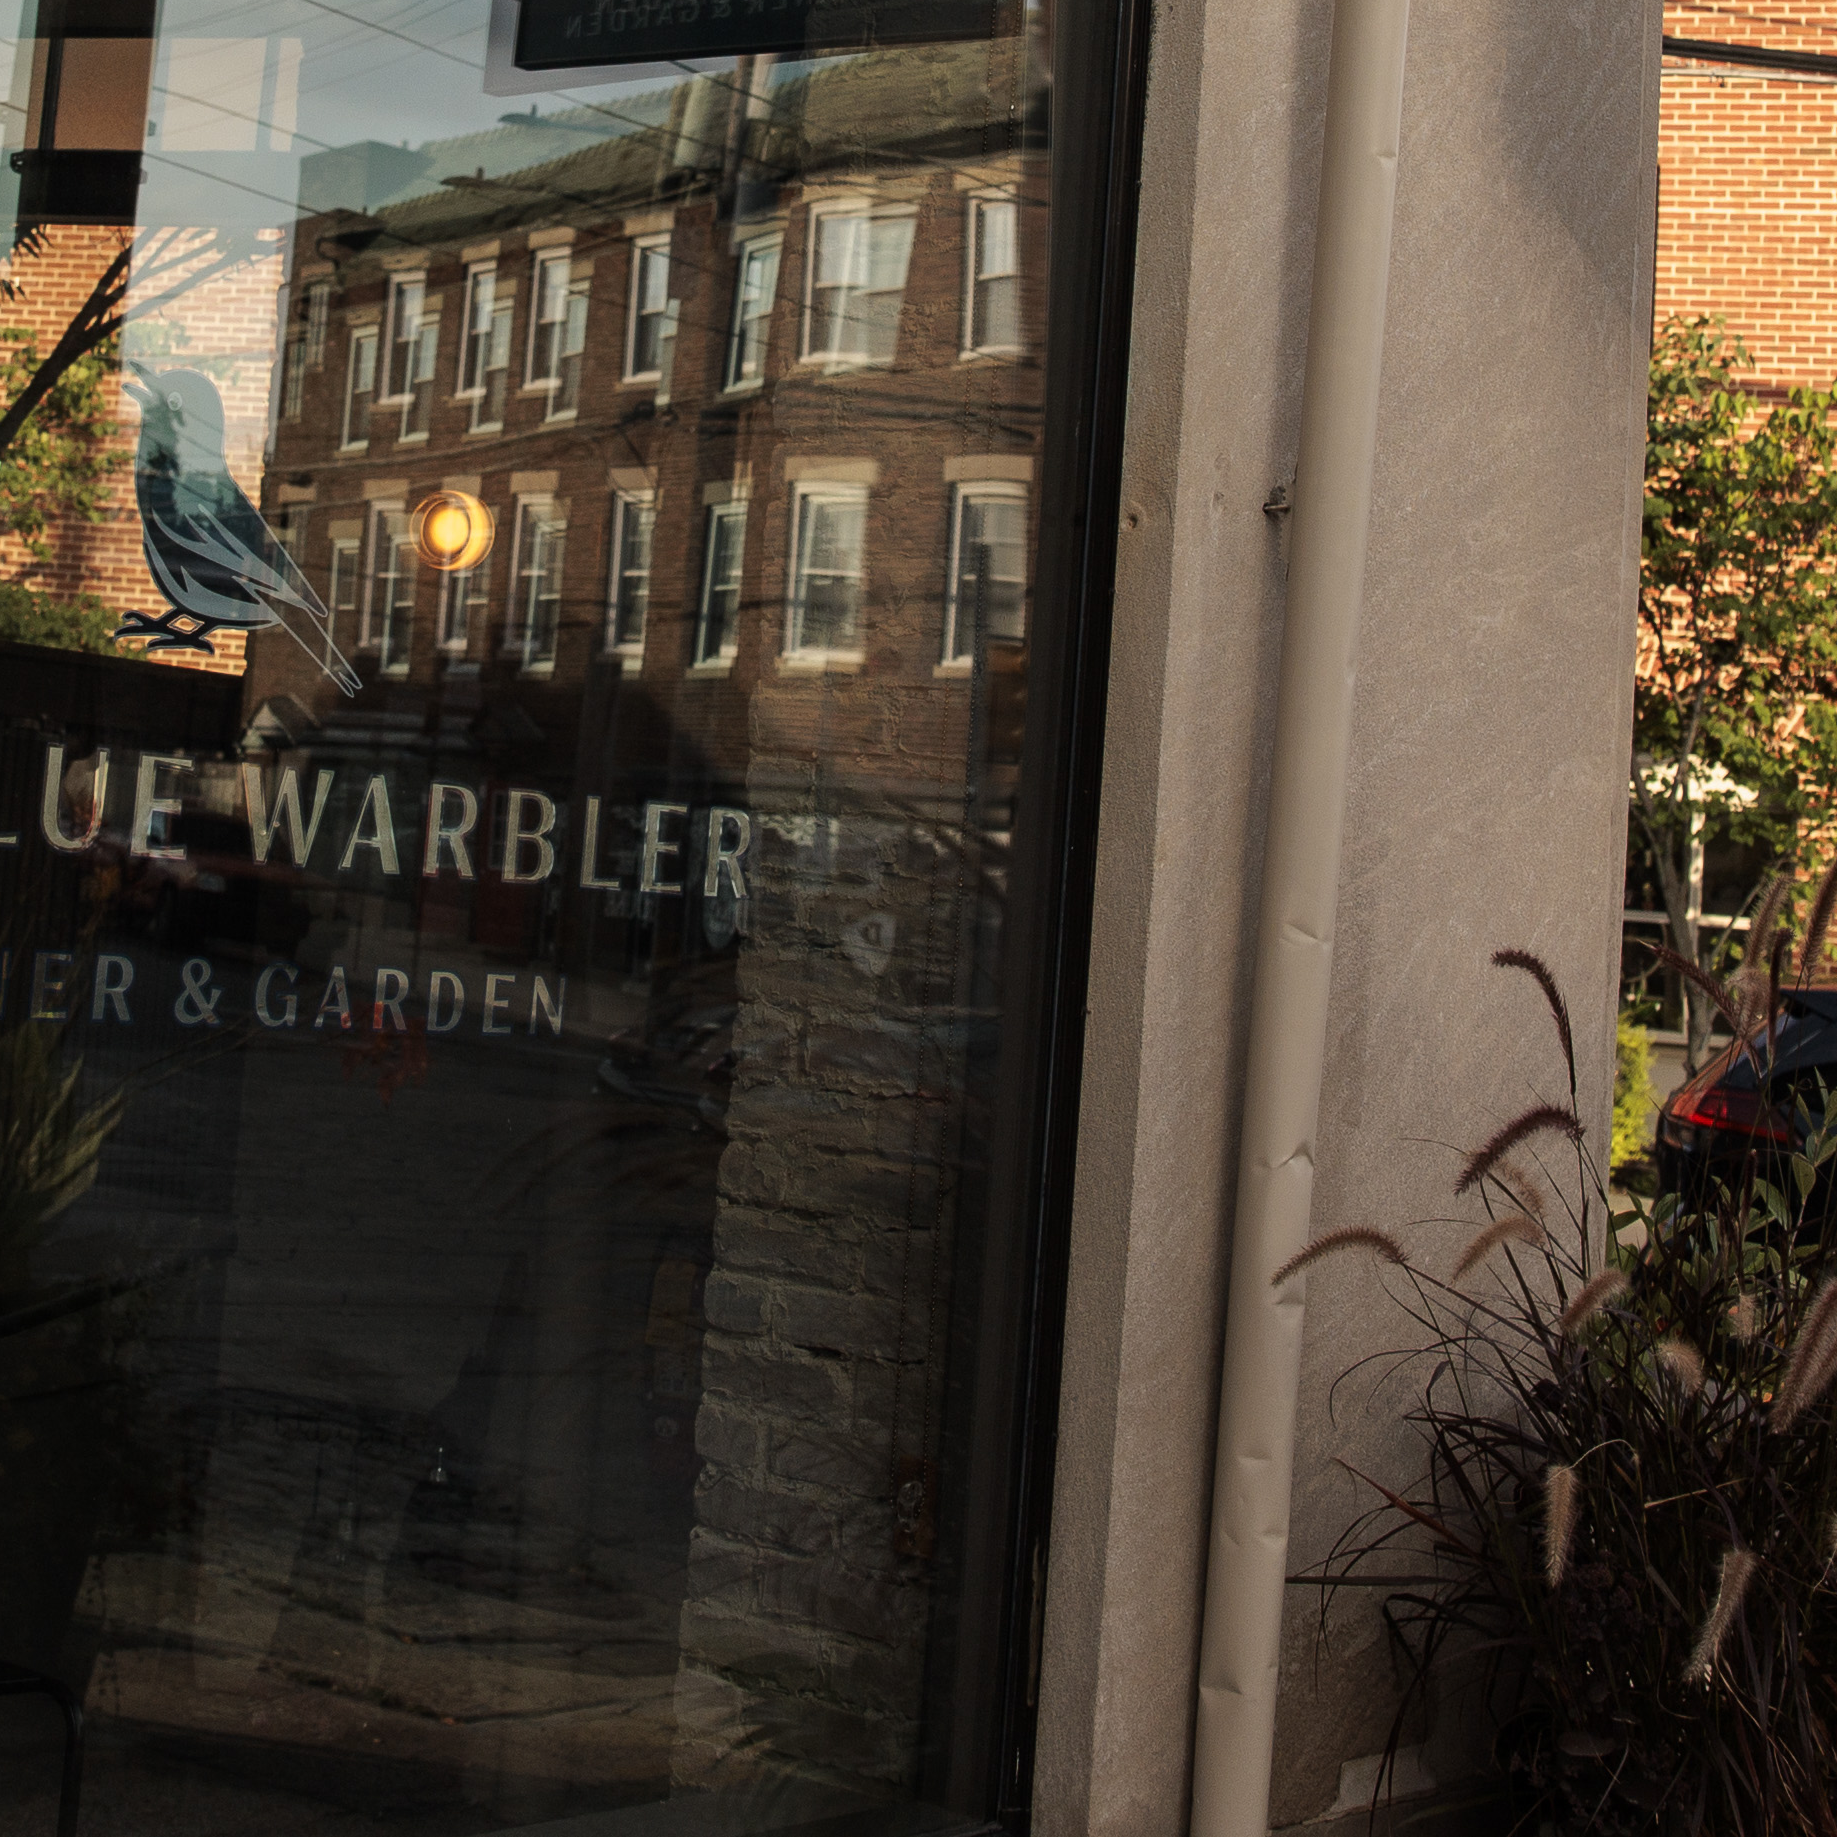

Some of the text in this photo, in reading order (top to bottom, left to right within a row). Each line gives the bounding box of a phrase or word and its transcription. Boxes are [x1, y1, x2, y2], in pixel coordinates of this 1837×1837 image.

[240, 761, 752, 900] WARBLER
[174, 958, 223, 1028] &
[255, 965, 565, 1036] GARDEN
